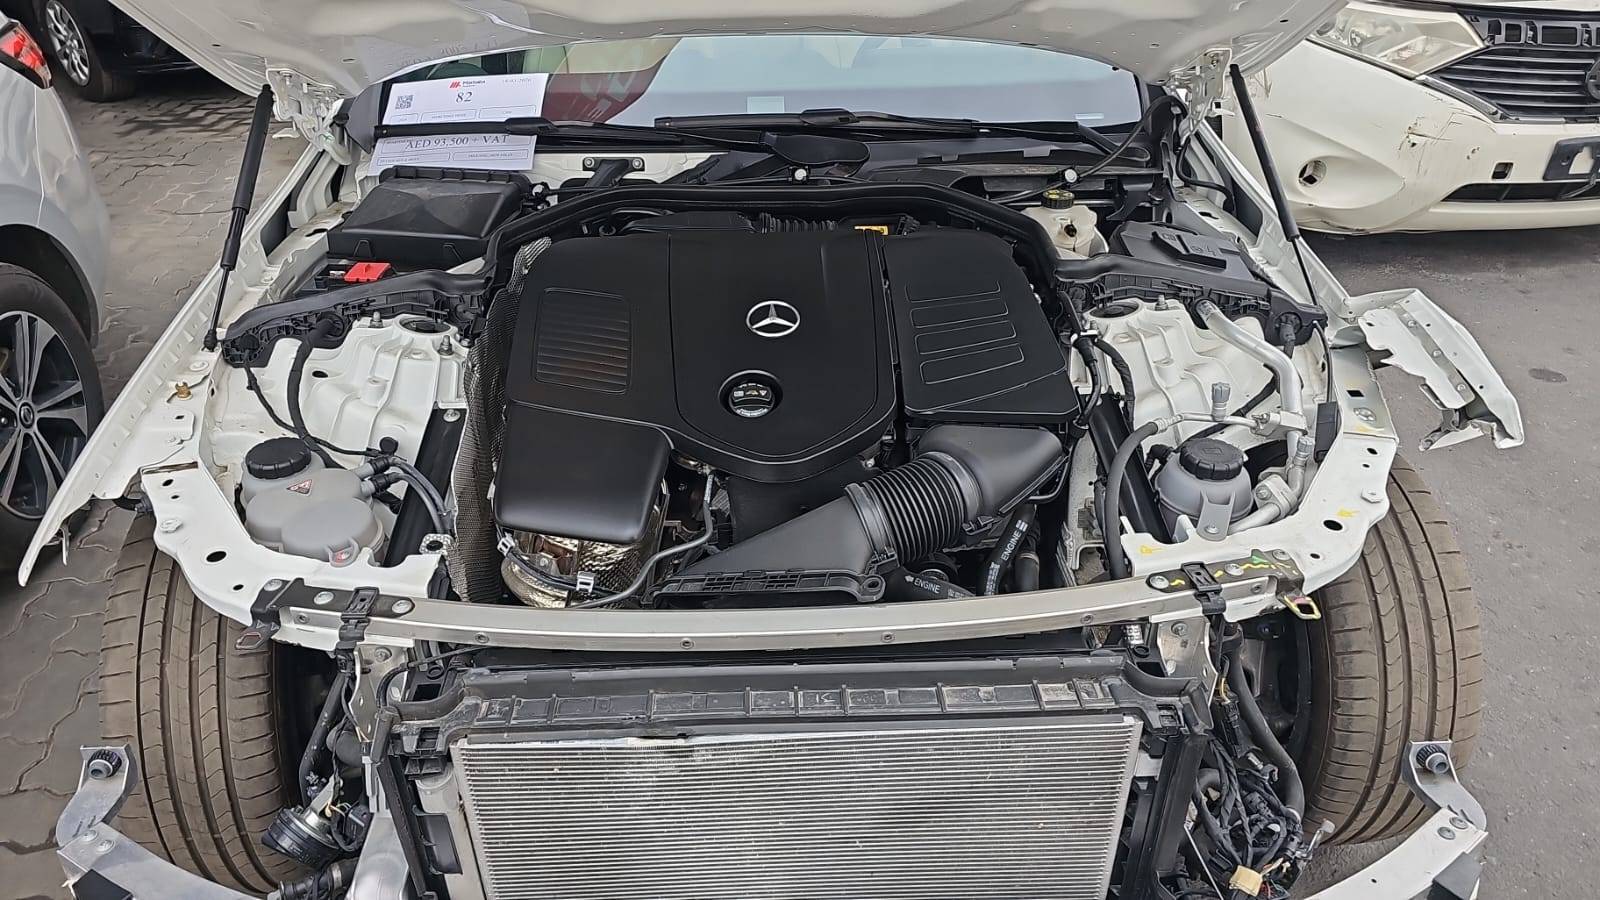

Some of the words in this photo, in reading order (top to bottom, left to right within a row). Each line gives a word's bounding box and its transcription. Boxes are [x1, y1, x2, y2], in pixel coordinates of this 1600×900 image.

[456, 91, 473, 103] 82
[405, 139, 431, 150] AED
[433, 136, 469, 148] 93,500
[483, 134, 509, 144] VAT
[1001, 529, 1022, 561] ENGINE
[914, 579, 941, 594] ENGINE
